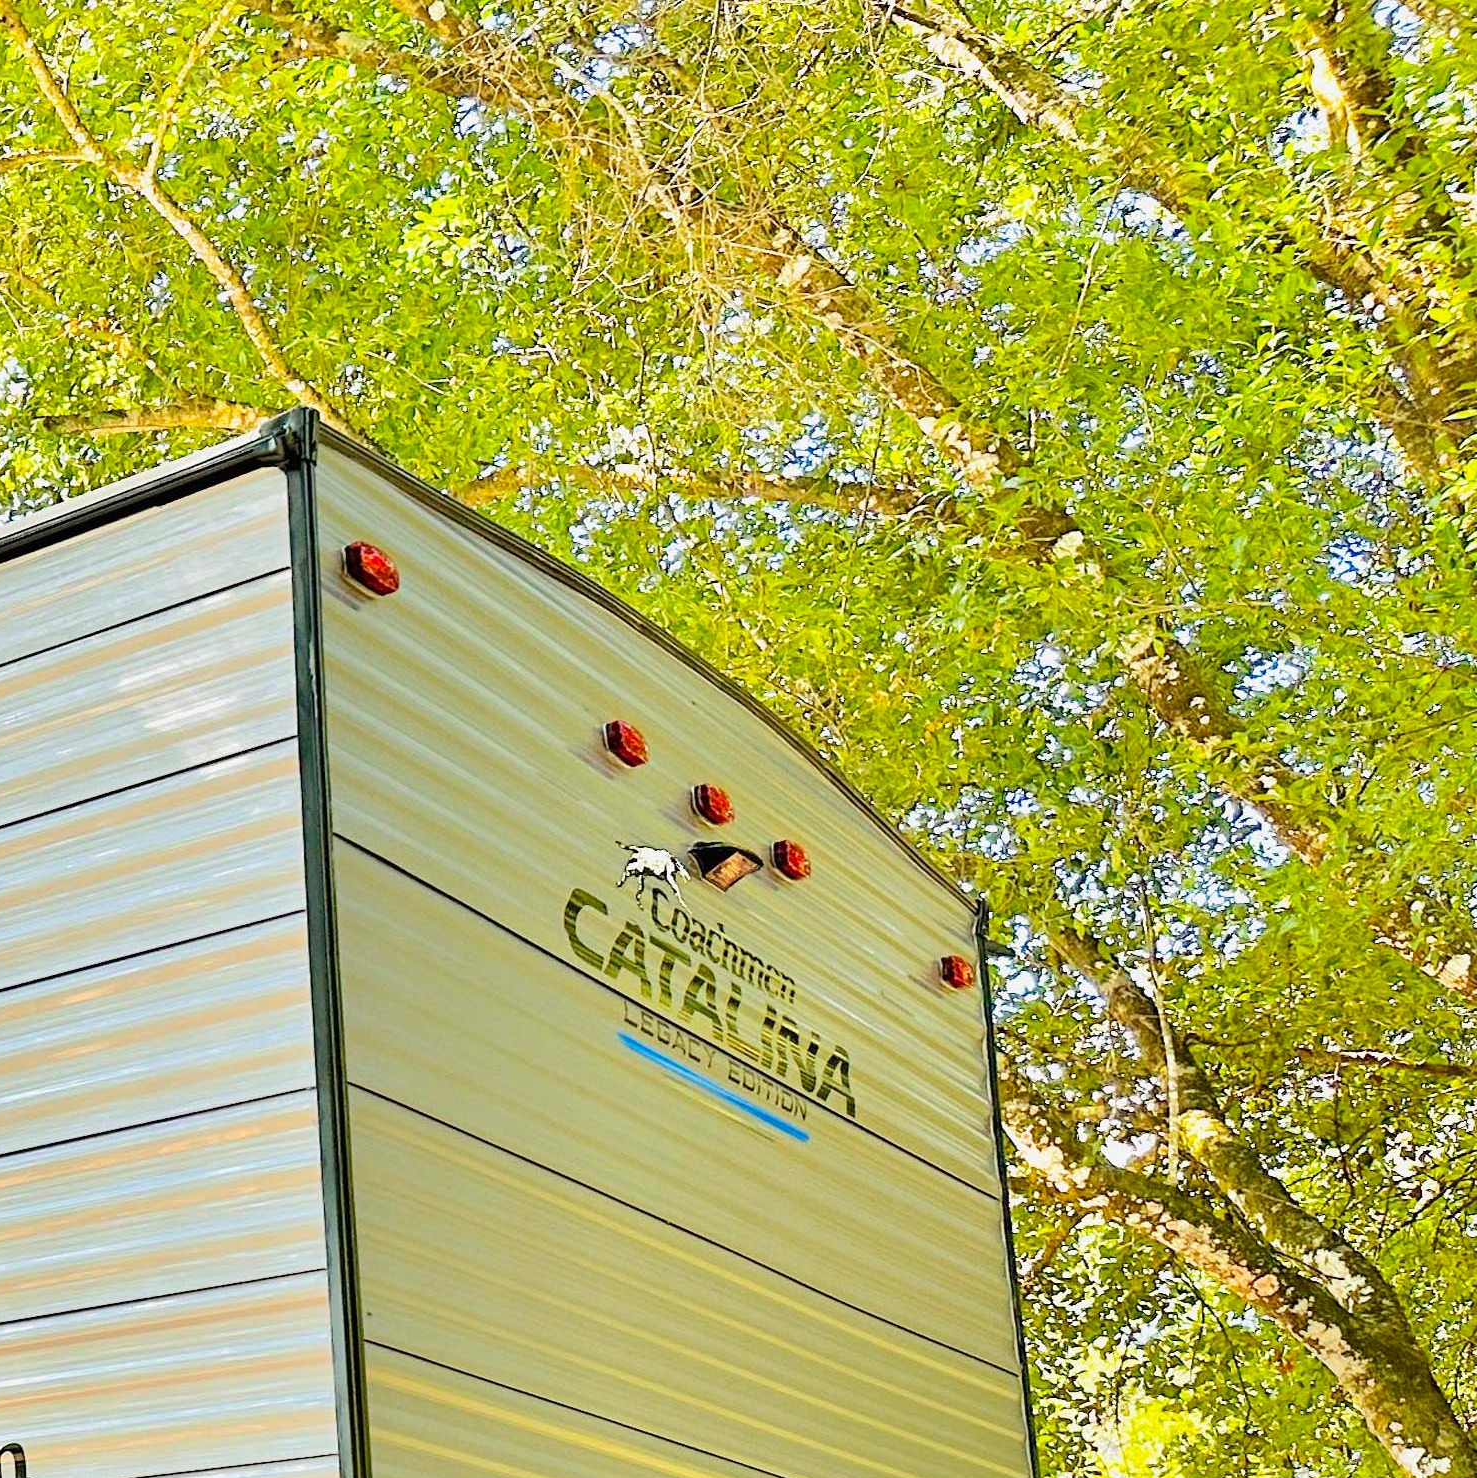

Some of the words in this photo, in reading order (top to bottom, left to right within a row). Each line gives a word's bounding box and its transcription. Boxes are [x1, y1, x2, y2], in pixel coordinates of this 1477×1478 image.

[563, 887, 857, 1118] CATALINA
[650, 887, 796, 1005] Coachmen
[623, 1002, 717, 1070] LEGACY
[727, 1062, 808, 1122] EDITION
